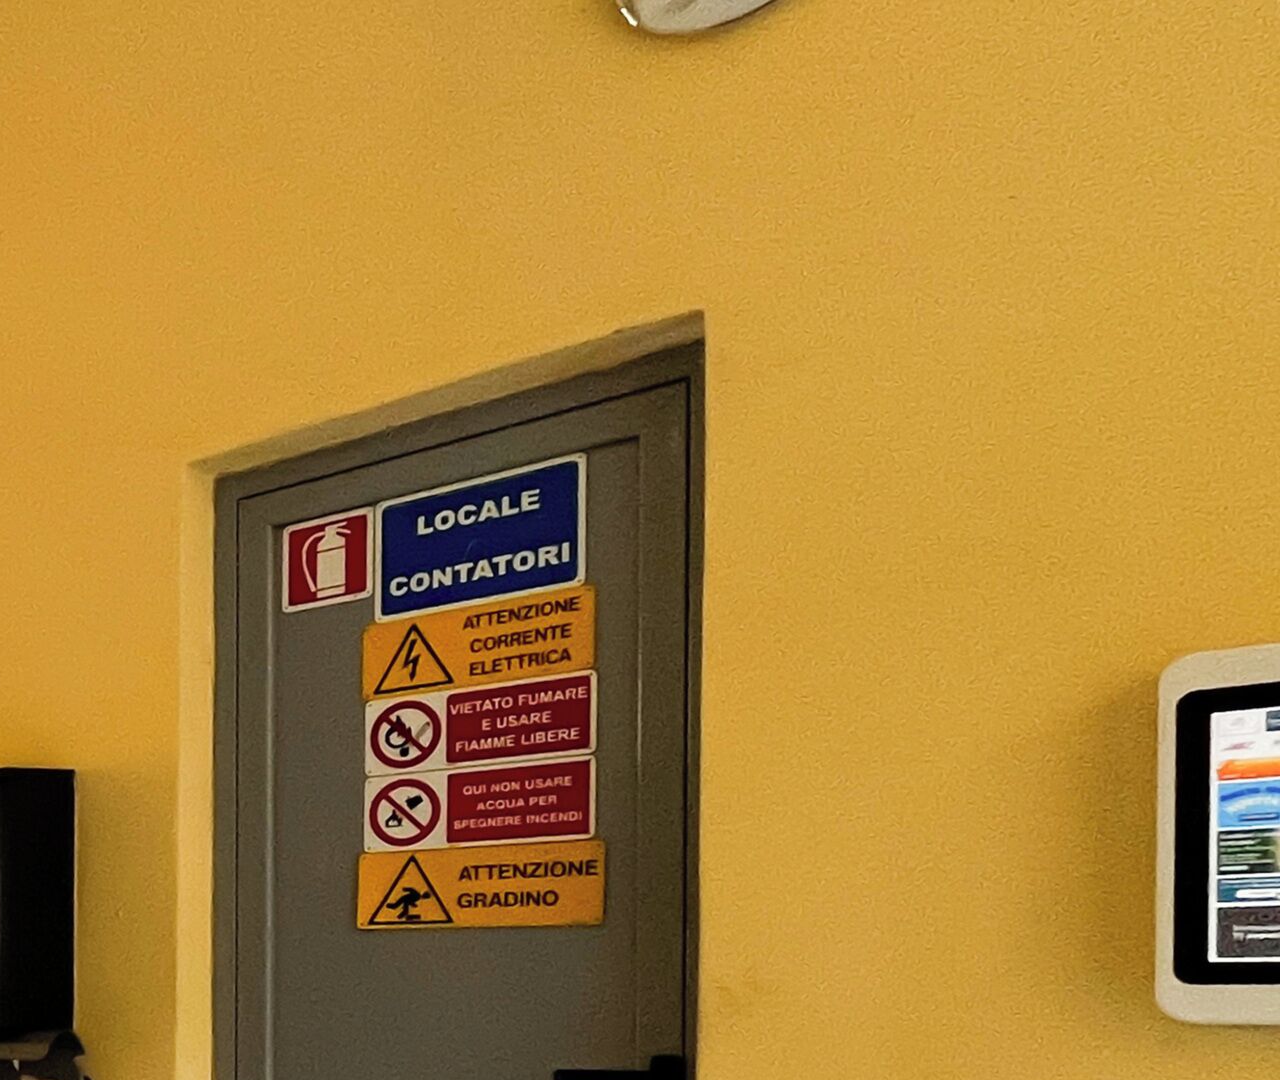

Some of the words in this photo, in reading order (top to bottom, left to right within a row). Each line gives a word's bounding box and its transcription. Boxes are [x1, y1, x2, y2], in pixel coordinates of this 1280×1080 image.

[416, 489, 540, 536] LOCALE
[389, 542, 570, 597] CONTATORI
[462, 595, 581, 631] ATTENZIONE
[470, 623, 573, 653] CORRENTE
[469, 648, 572, 677] ELETTRICA
[450, 696, 513, 715] VIETATO
[518, 686, 588, 707] FUMARE
[481, 718, 492, 731] E
[496, 711, 552, 729] USARE
[455, 734, 516, 753] FIAMME
[521, 727, 581, 745] LIBERE
[462, 785, 487, 796] QUI
[490, 781, 521, 793] NON
[525, 776, 573, 790] USARE
[476, 798, 525, 811] ACQUA
[529, 795, 557, 806] PER
[453, 815, 522, 830] SPEGNERE
[526, 811, 583, 824] INCENDI
[458, 859, 599, 881] ATTENZIONE
[457, 890, 559, 908] GRADINO
